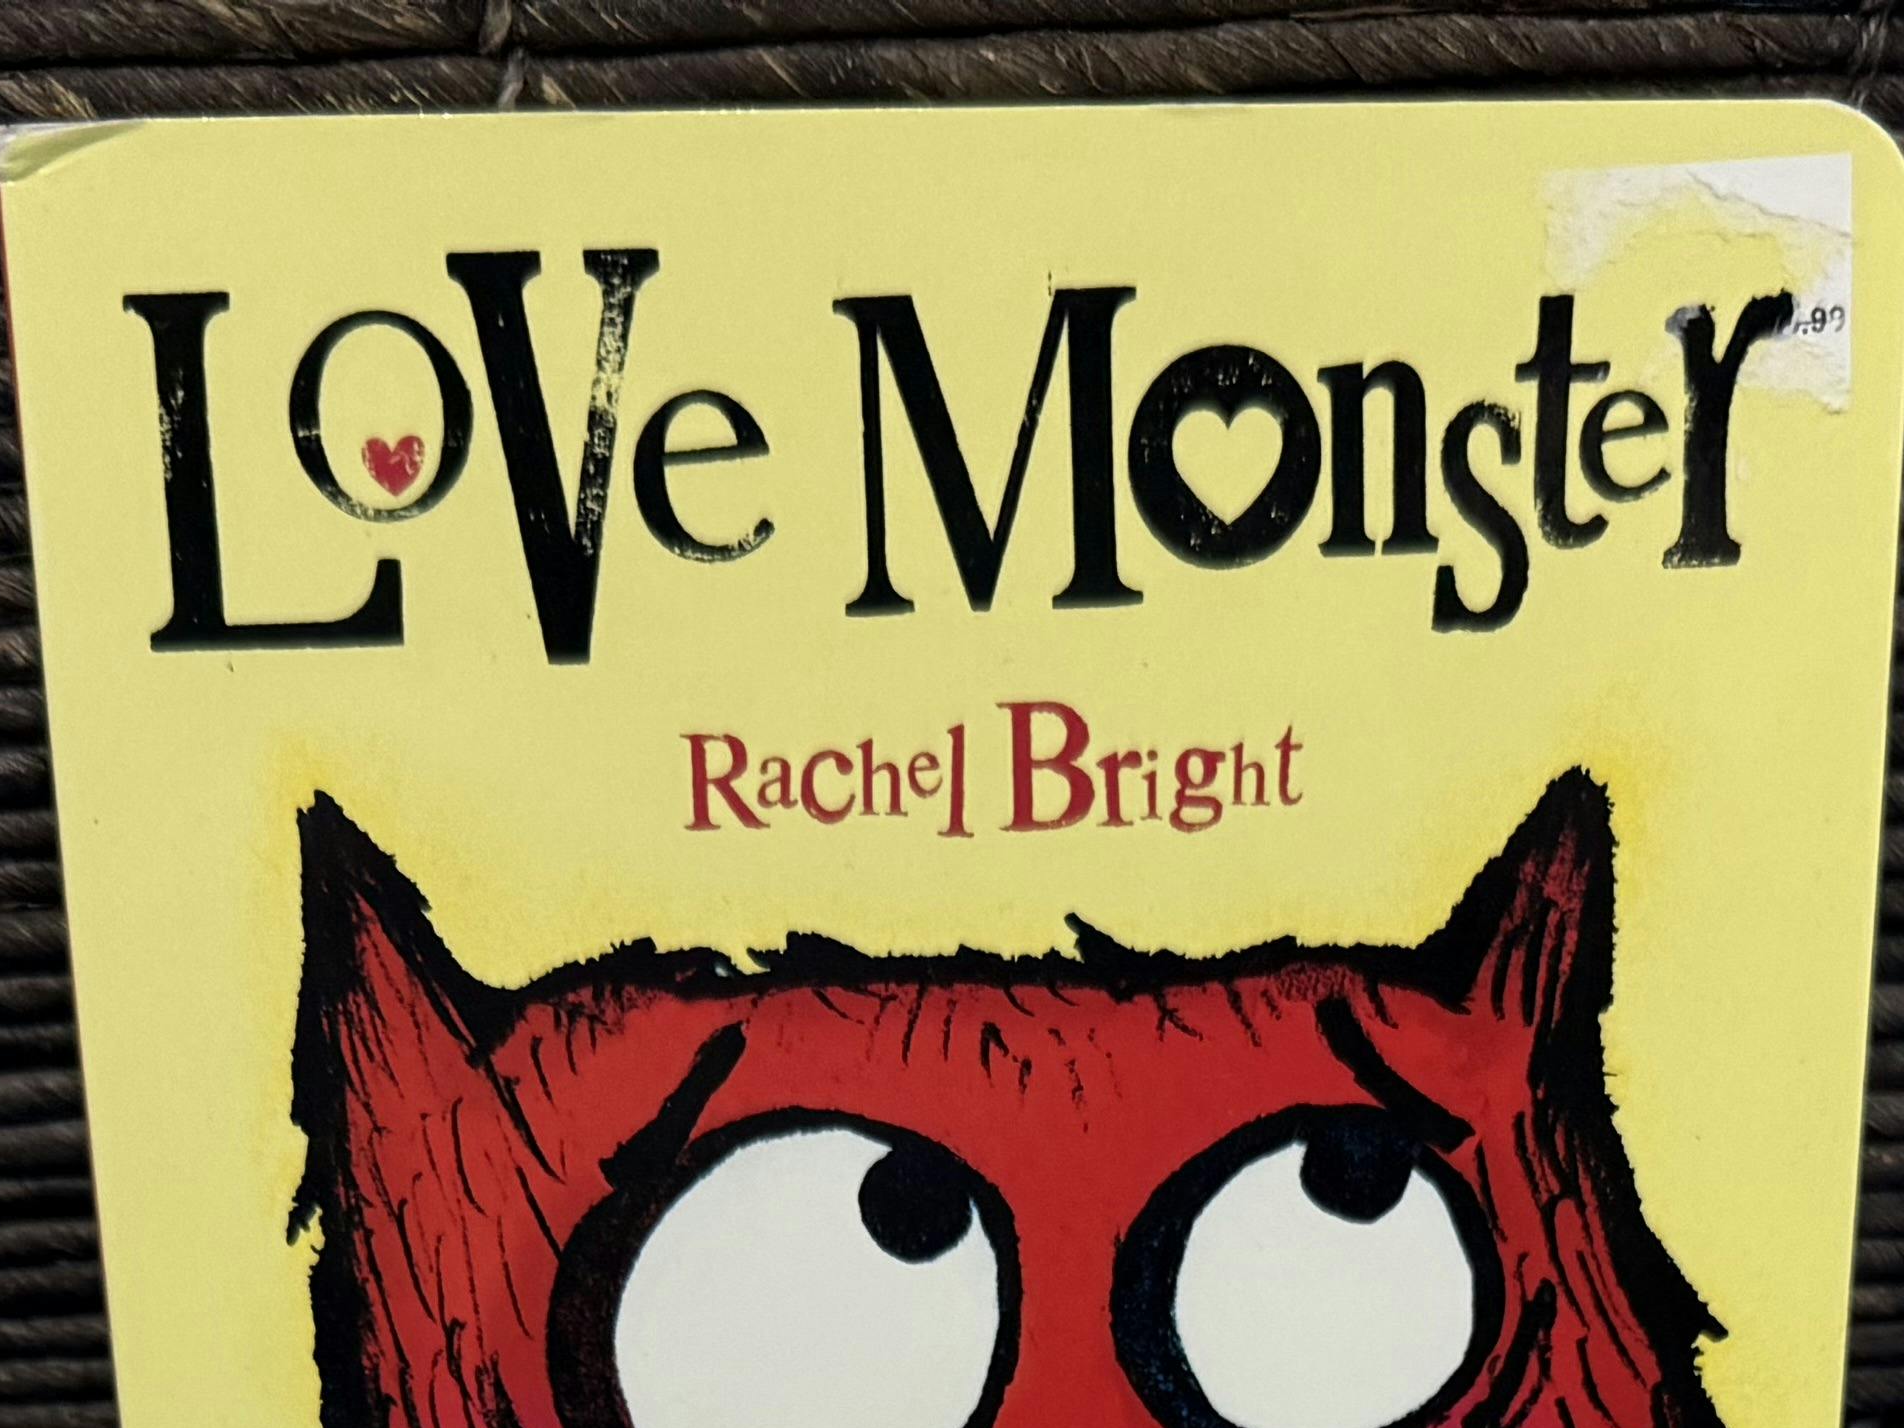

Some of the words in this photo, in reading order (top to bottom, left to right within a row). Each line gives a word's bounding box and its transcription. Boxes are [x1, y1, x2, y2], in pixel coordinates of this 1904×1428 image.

[832, 284, 1795, 634] Monster
[680, 723, 969, 837] Rachel
[996, 699, 1304, 834] Bright
